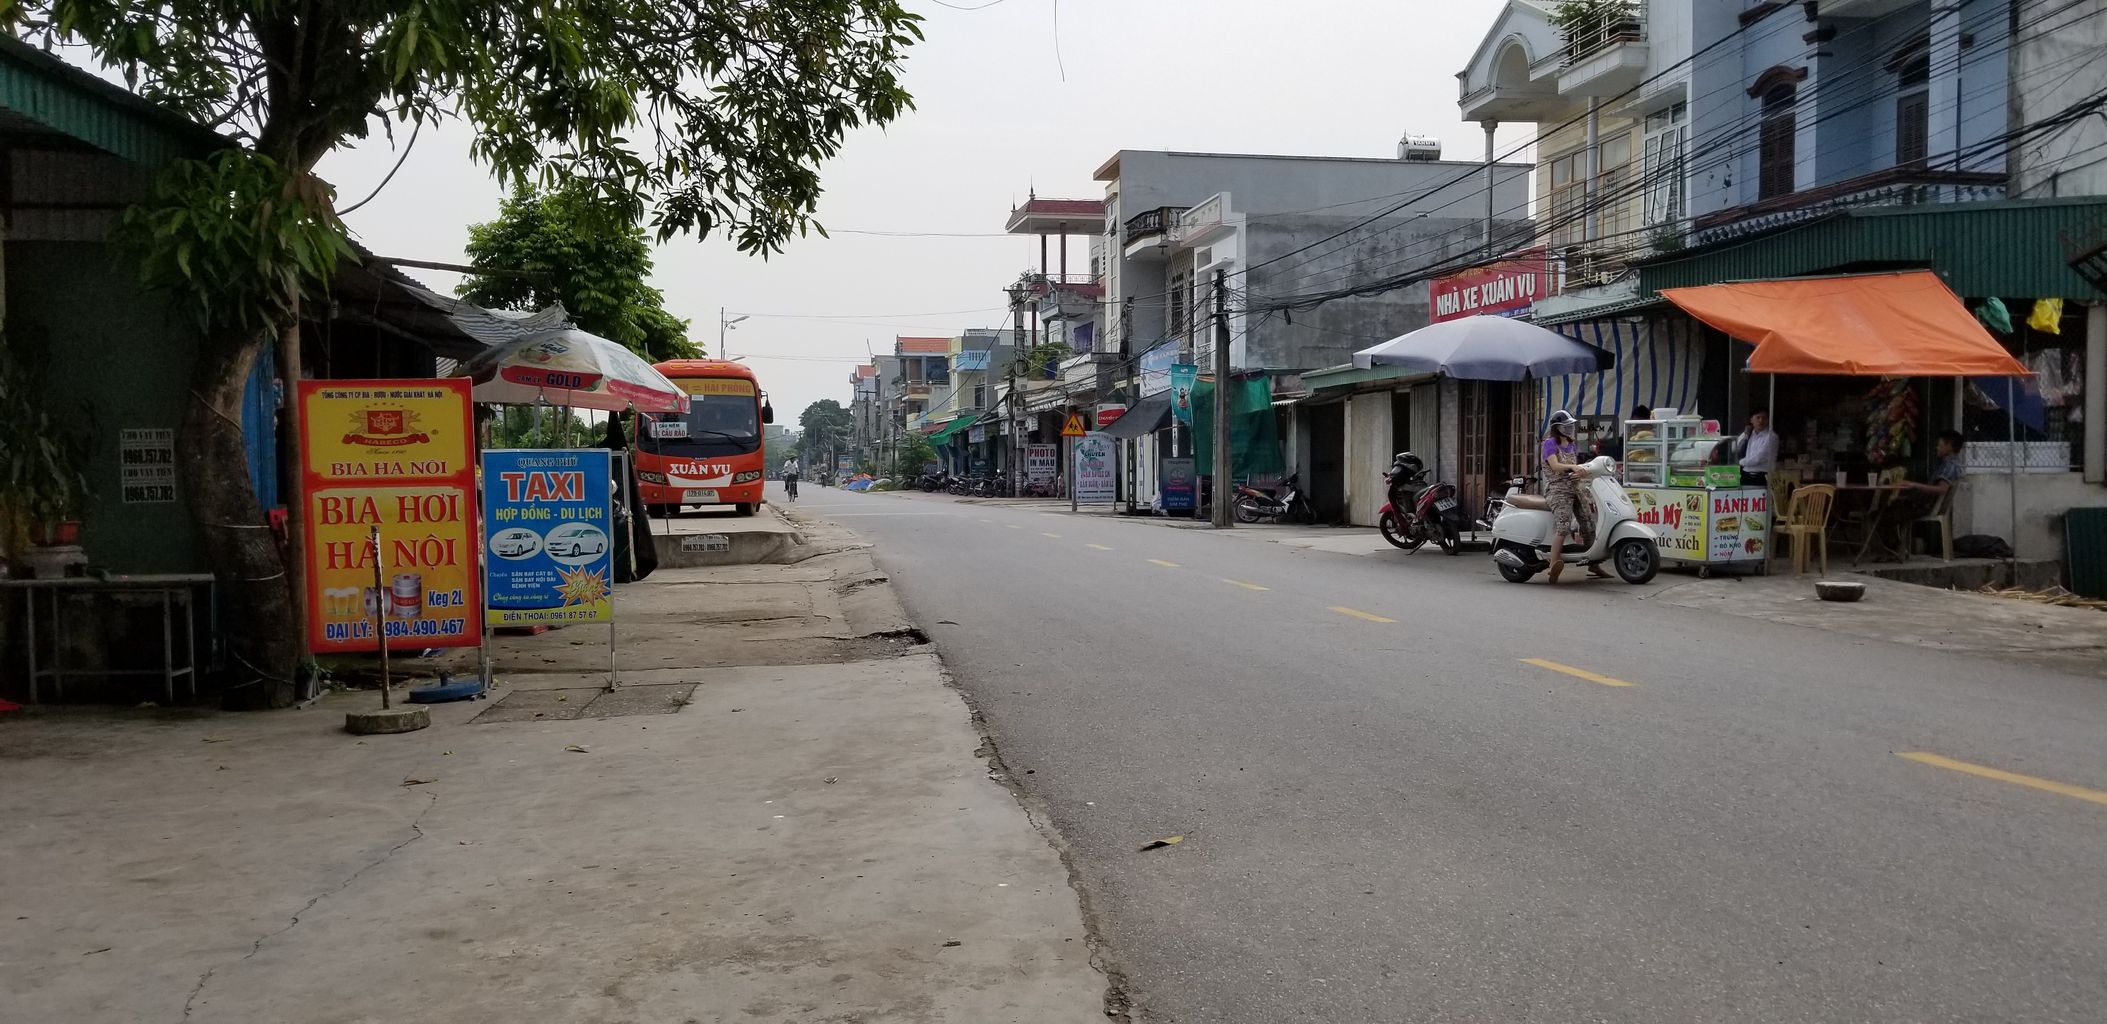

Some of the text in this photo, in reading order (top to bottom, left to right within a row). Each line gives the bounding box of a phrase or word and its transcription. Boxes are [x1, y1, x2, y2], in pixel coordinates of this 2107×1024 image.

[1437, 273, 1536, 317] NHÀ XE XUÂN VỤ
[546, 373, 582, 388] GOLD
[364, 437, 408, 446] HABECO
[1029, 448, 1056, 458] PHOTO
[331, 462, 367, 476] BIA
[517, 457, 555, 468] QUANG
[669, 461, 708, 475] XUÂN
[1030, 459, 1039, 467] IN
[500, 471, 585, 502] TAXI
[319, 493, 461, 525] BIA HƠI
[495, 506, 518, 523] HỢP
[521, 503, 551, 520] ĐỒNG
[561, 507, 575, 519] DU
[578, 507, 602, 522] LỊCH
[1714, 494, 1749, 514] BÁNH
[1637, 506, 1660, 525] ánh
[1653, 531, 1700, 551] xúc xích
[325, 533, 457, 570] HÀ NỘI
[428, 590, 449, 607] Keg
[451, 590, 464, 606] 2L
[550, 611, 566, 620] 0961
[568, 611, 577, 620] 87
[578, 611, 587, 619] 57
[588, 610, 597, 619] 67
[326, 618, 465, 642] ĐẠI LÝ: 984.490.467
